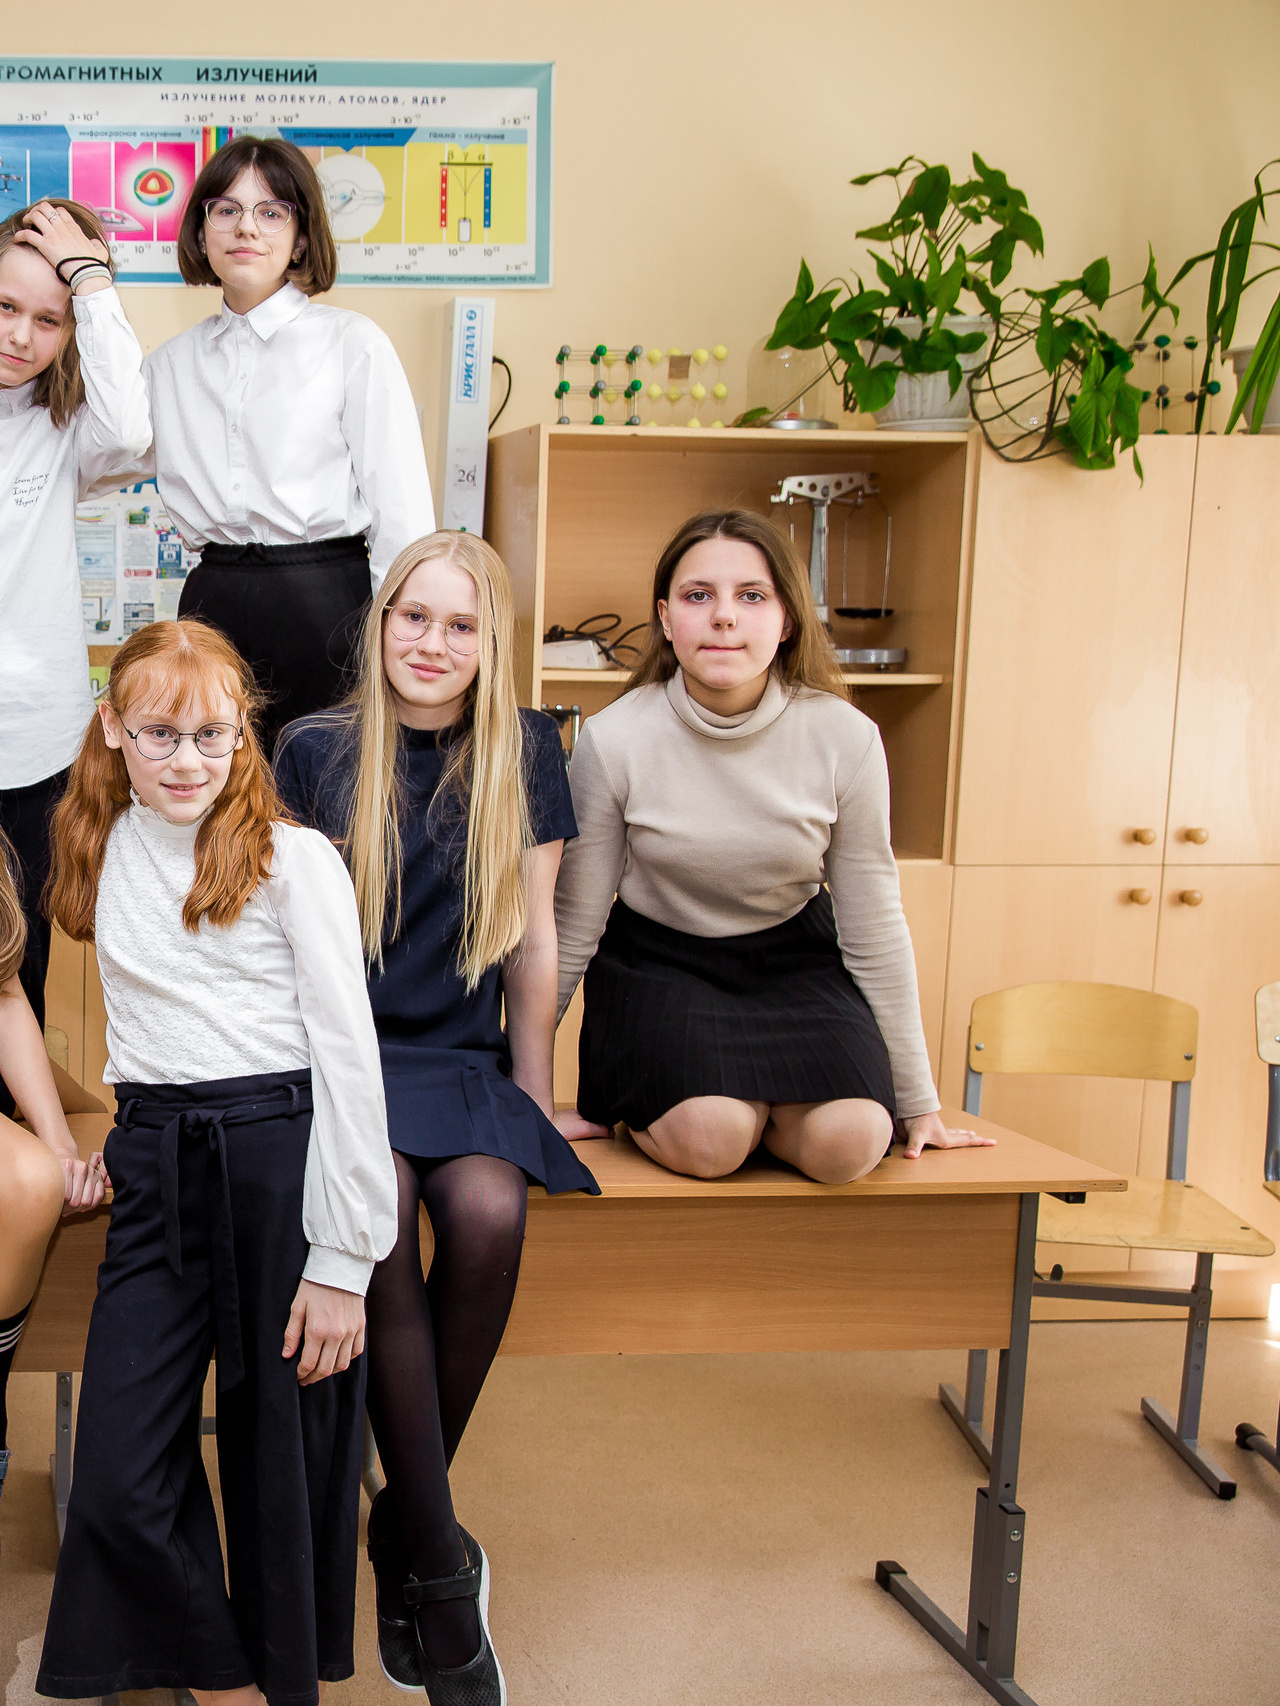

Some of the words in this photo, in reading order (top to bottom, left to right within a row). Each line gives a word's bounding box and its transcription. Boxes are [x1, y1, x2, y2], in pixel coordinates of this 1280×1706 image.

[196, 64, 318, 83] ИЗЛУЧЕНИЙ
[160, 93, 247, 102] ИЗЛУЧЕНИЕ
[255, 94, 332, 105] МОЛЕКУЛ,
[338, 95, 406, 106] АТОМОВ,
[411, 96, 448, 106] ЯДЕР
[462, 325, 477, 398] КРИСТАЛЛ
[457, 468, 476, 483] 26
